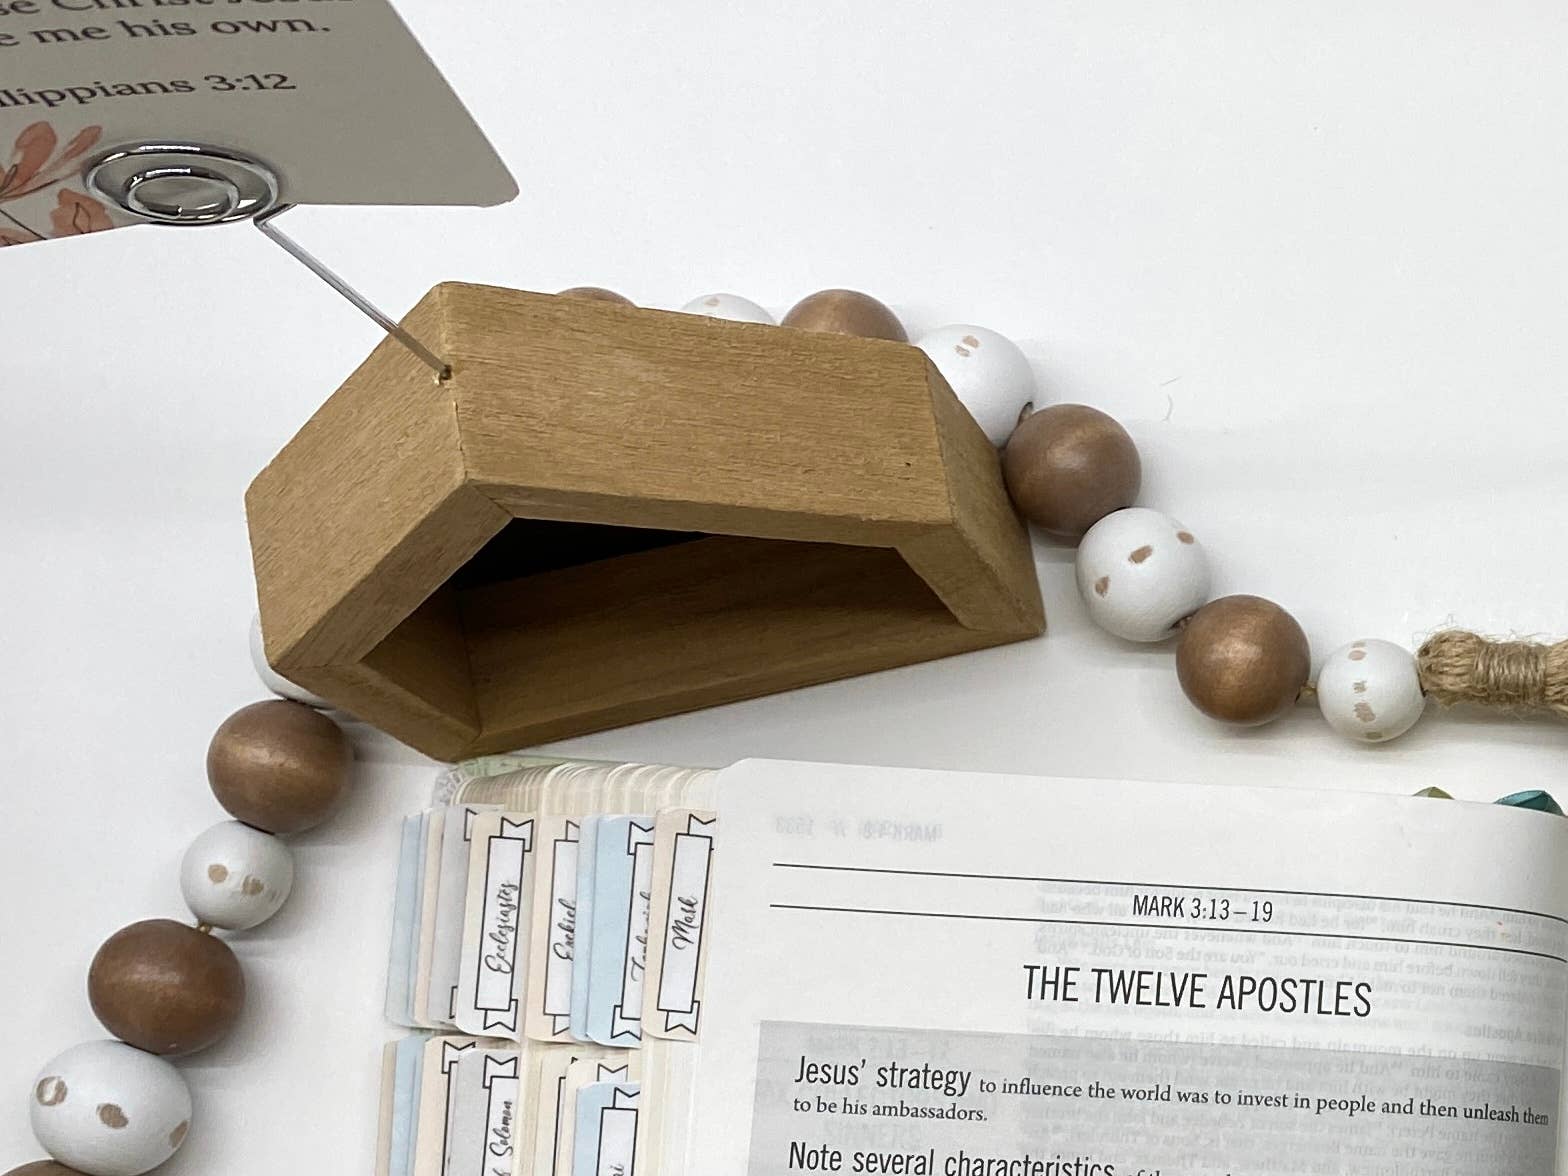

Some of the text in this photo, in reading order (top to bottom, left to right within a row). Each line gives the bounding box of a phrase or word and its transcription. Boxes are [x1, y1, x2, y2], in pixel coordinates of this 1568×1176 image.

[31, 24, 110, 44] me
[116, 19, 198, 39] his
[210, 18, 331, 35] own.
[204, 73, 297, 93] 3:12
[485, 880, 518, 975] Ecclesiastes
[671, 894, 698, 951] Mark
[1131, 893, 1185, 919] MARK
[1023, 964, 1372, 1018] THE TWELVE APOSTLES
[793, 1095, 988, 1122] to be his ambassadors.
[794, 1055, 1549, 1127] Jesus’ strategy to influence the world was to invest in people and then unleash them
[489, 1099, 514, 1157] Solomon
[789, 1141, 842, 1172] Note
[852, 1148, 935, 1176] several
